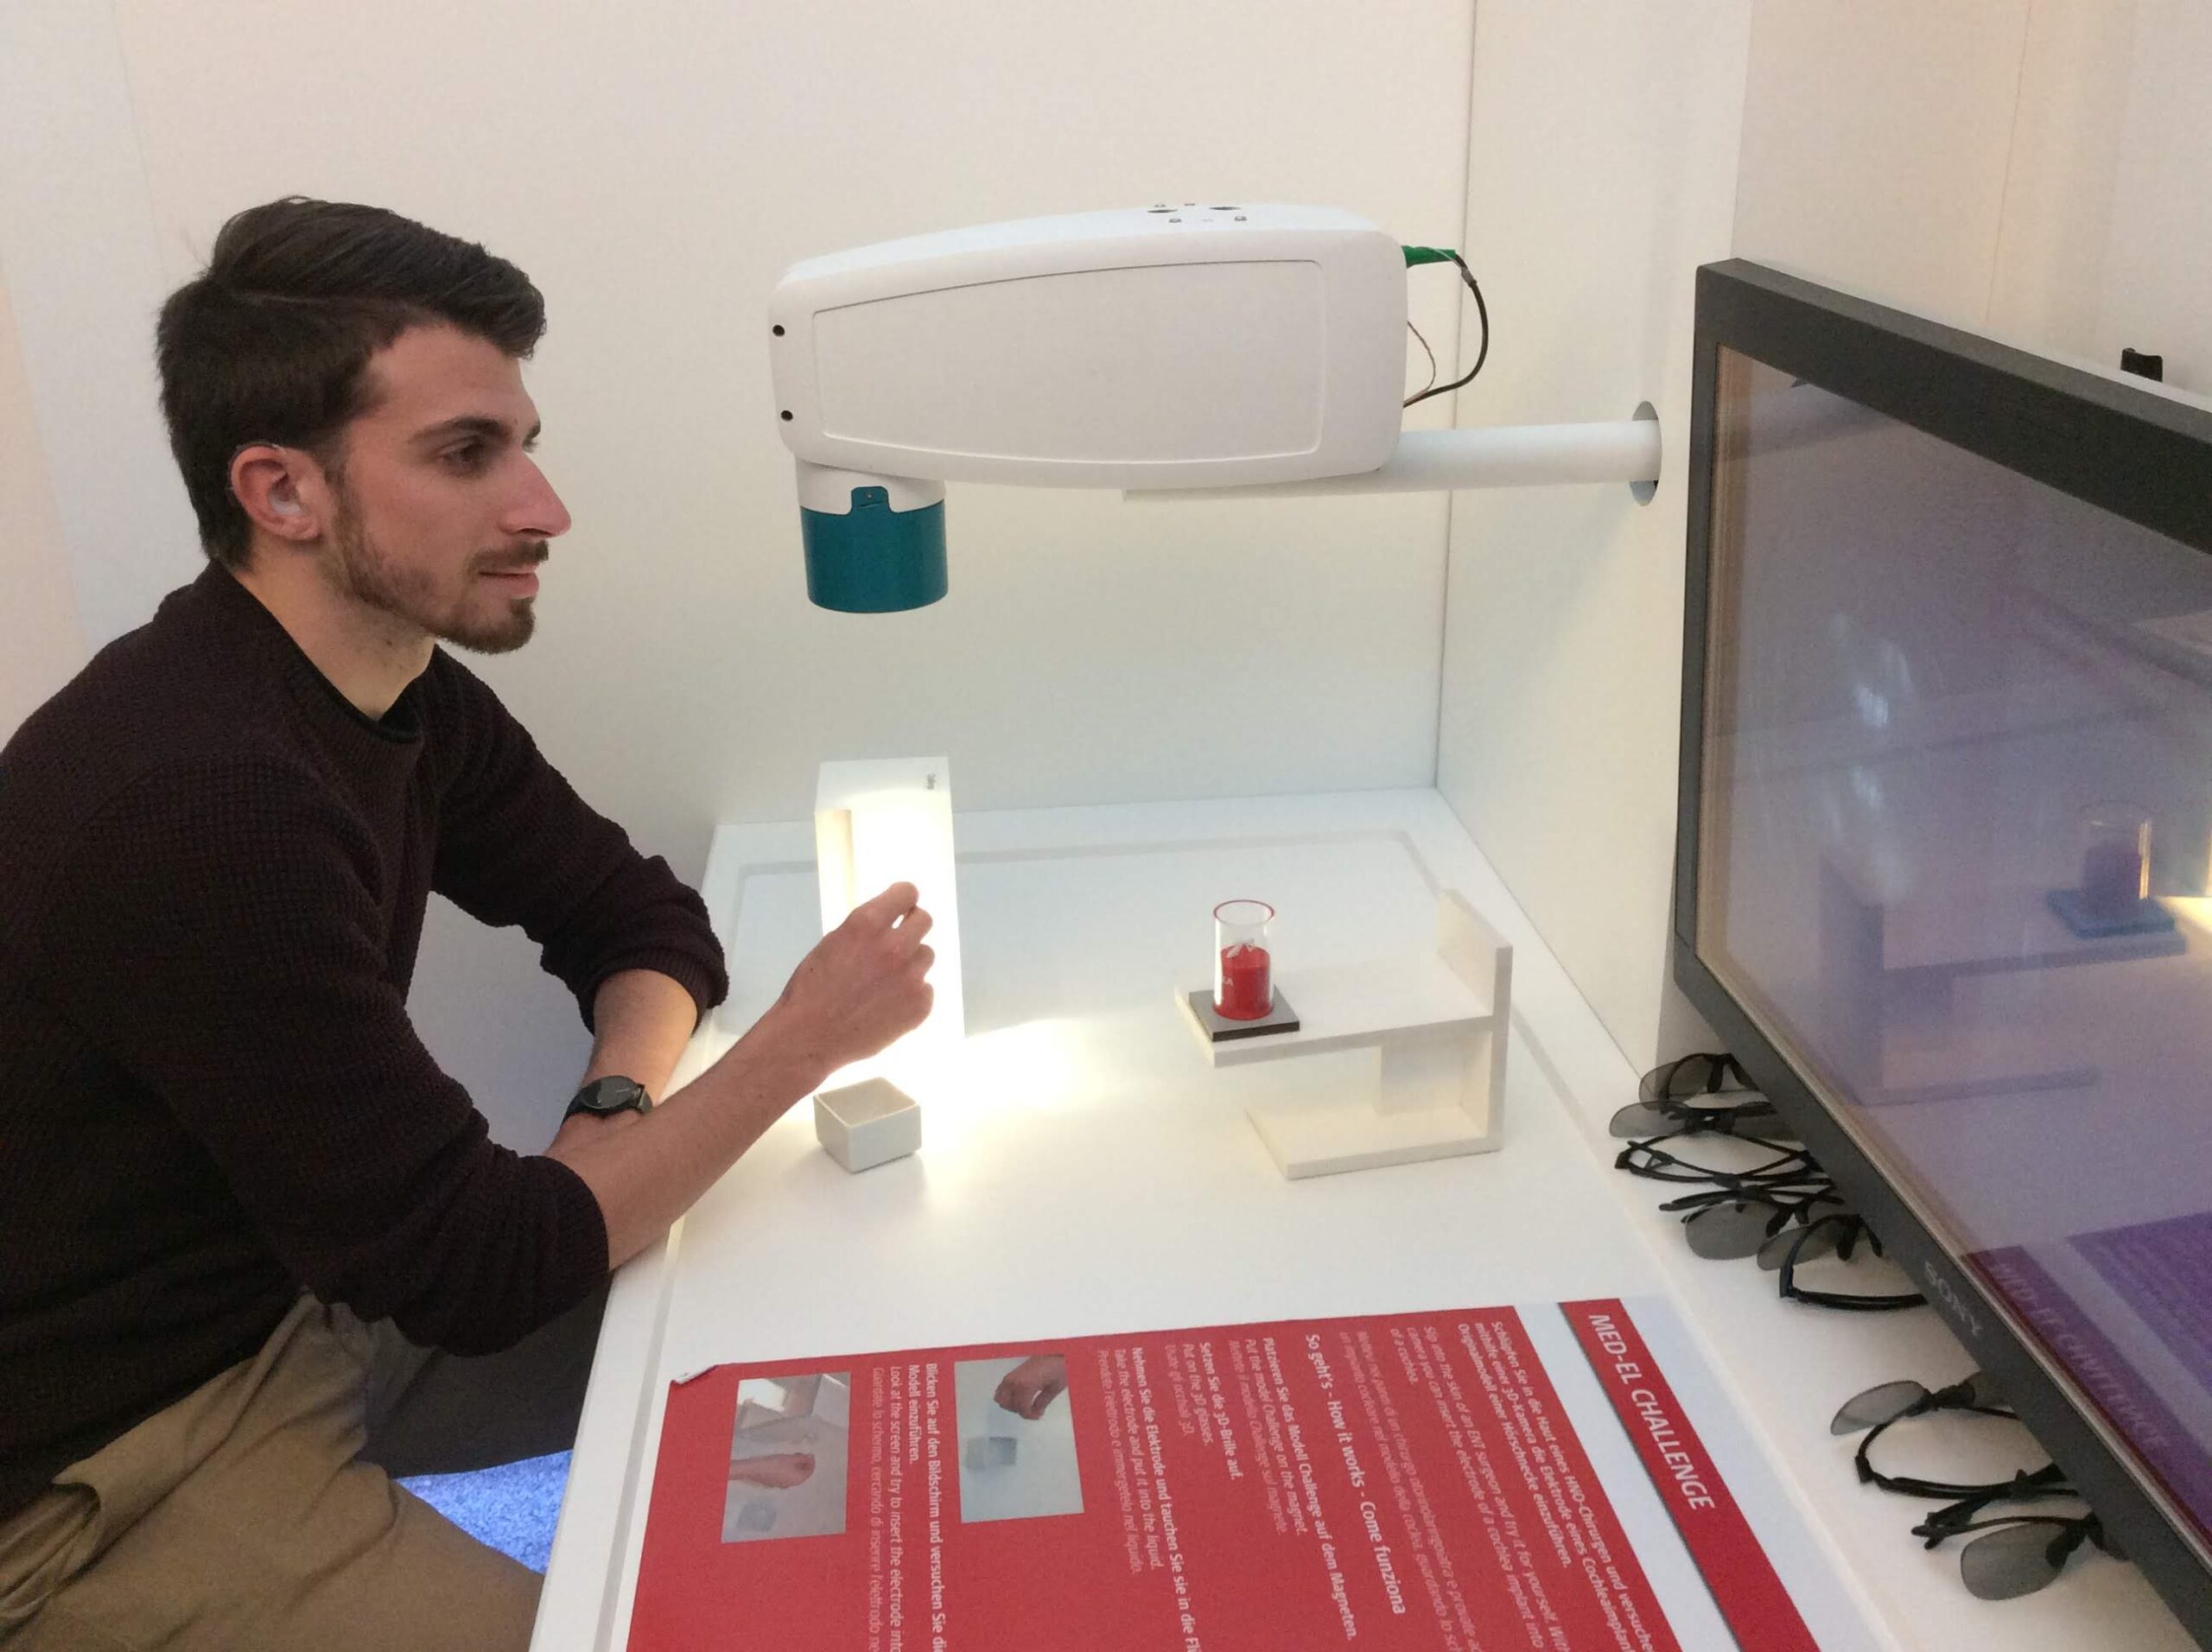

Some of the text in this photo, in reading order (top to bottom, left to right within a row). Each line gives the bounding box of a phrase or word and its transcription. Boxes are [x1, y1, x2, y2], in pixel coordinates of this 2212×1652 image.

[1924, 1261, 1983, 1338] SONY
[1305, 1334, 1320, 1350] So
[1491, 1321, 1520, 1368] Schlüpfen
[1114, 1348, 1128, 1369] Take
[1132, 1347, 1147, 1388] Nehmen
[1199, 1342, 1216, 1375] Setzen
[1262, 1337, 1284, 1385] Platzieren
[1307, 1351, 1334, 1389] geht's
[890, 1366, 903, 1388] Look
[925, 1363, 938, 1398] Blicken
[1118, 1370, 1131, 1387] the
[1207, 1376, 1220, 1392] Sie
[1513, 1369, 1528, 1385] Sie
[890, 1389, 902, 1400] at
[1139, 1388, 1153, 1405] Sie
[1211, 1393, 1225, 1410] die
[1275, 1386, 1289, 1402] Sie
[1522, 1386, 1534, 1397] in
[890, 1401, 903, 1420] the
[908, 1364, 923, 1465] Modell einzuführen.
[926, 1399, 939, 1416] Sie
[1121, 1388, 1140, 1435] electrode
[1142, 1406, 1155, 1423] die
[1281, 1403, 1295, 1423] das
[1326, 1401, 1346, 1430] How
[1458, 1323, 1498, 1392] Originalmodell
[1488, 1393, 1508, 1420] einer
[1501, 1421, 1539, 1491] Hörschnecke
[1527, 1398, 1542, 1414] die
[1588, 1314, 1715, 1510] MED-EL CHALLENGE
[890, 1420, 901, 1454] screen
[926, 1417, 941, 1435] auf
[1212, 1411, 1237, 1457] 3D-Brille
[1535, 1416, 1557, 1442] Haut
[927, 1437, 941, 1458] den
[1128, 1435, 1145, 1456] and
[1287, 1424, 1309, 1461] Modell
[1337, 1432, 1353, 1444] it
[1474, 1322, 1499, 1359] mithilfe
[1491, 1360, 1510, 1385] einer
[1501, 1388, 1537, 1445] 3D-Kamera
[1530, 1446, 1546, 1464] die
[1539, 1465, 1573, 1521] Elektrode
[1565, 1522, 1588, 1555] eines
[1145, 1424, 1166, 1477] Elektrode
[1548, 1444, 1570, 1474] eines
[890, 1455, 903, 1477] and
[1129, 1458, 1147, 1476] put
[1341, 1445, 1365, 1488] works
[887, 1477, 902, 1495] try
[927, 1459, 942, 1518] Bildschirm
[1136, 1477, 1149, 1487] it
[1155, 1478, 1173, 1501] und
[1298, 1463, 1322, 1518] Challenge
[889, 1496, 903, 1509] to
[1137, 1488, 1152, 1511] into
[890, 1510, 903, 1543] insert
[1142, 1512, 1156, 1533] the
[1160, 1502, 1179, 1551] tauchen
[1314, 1520, 1333, 1540] auf
[1359, 1501, 1382, 1542] Come
[1564, 1475, 1611, 1563] HNO-Chirurgen
[929, 1520, 944, 1544] und
[890, 1546, 904, 1566] the
[1169, 1553, 1185, 1573] Sie
[1321, 1542, 1338, 1571] dem
[930, 1545, 945, 1611] versuchen
[1173, 1575, 1188, 1595] sie
[1374, 1545, 1406, 1615] funziona
[1605, 1566, 1629, 1591] und
[889, 1568, 905, 1628] electrode
[1177, 1597, 1192, 1611] in
[931, 1612, 946, 1634] Sie
[1180, 1613, 1196, 1635] die
